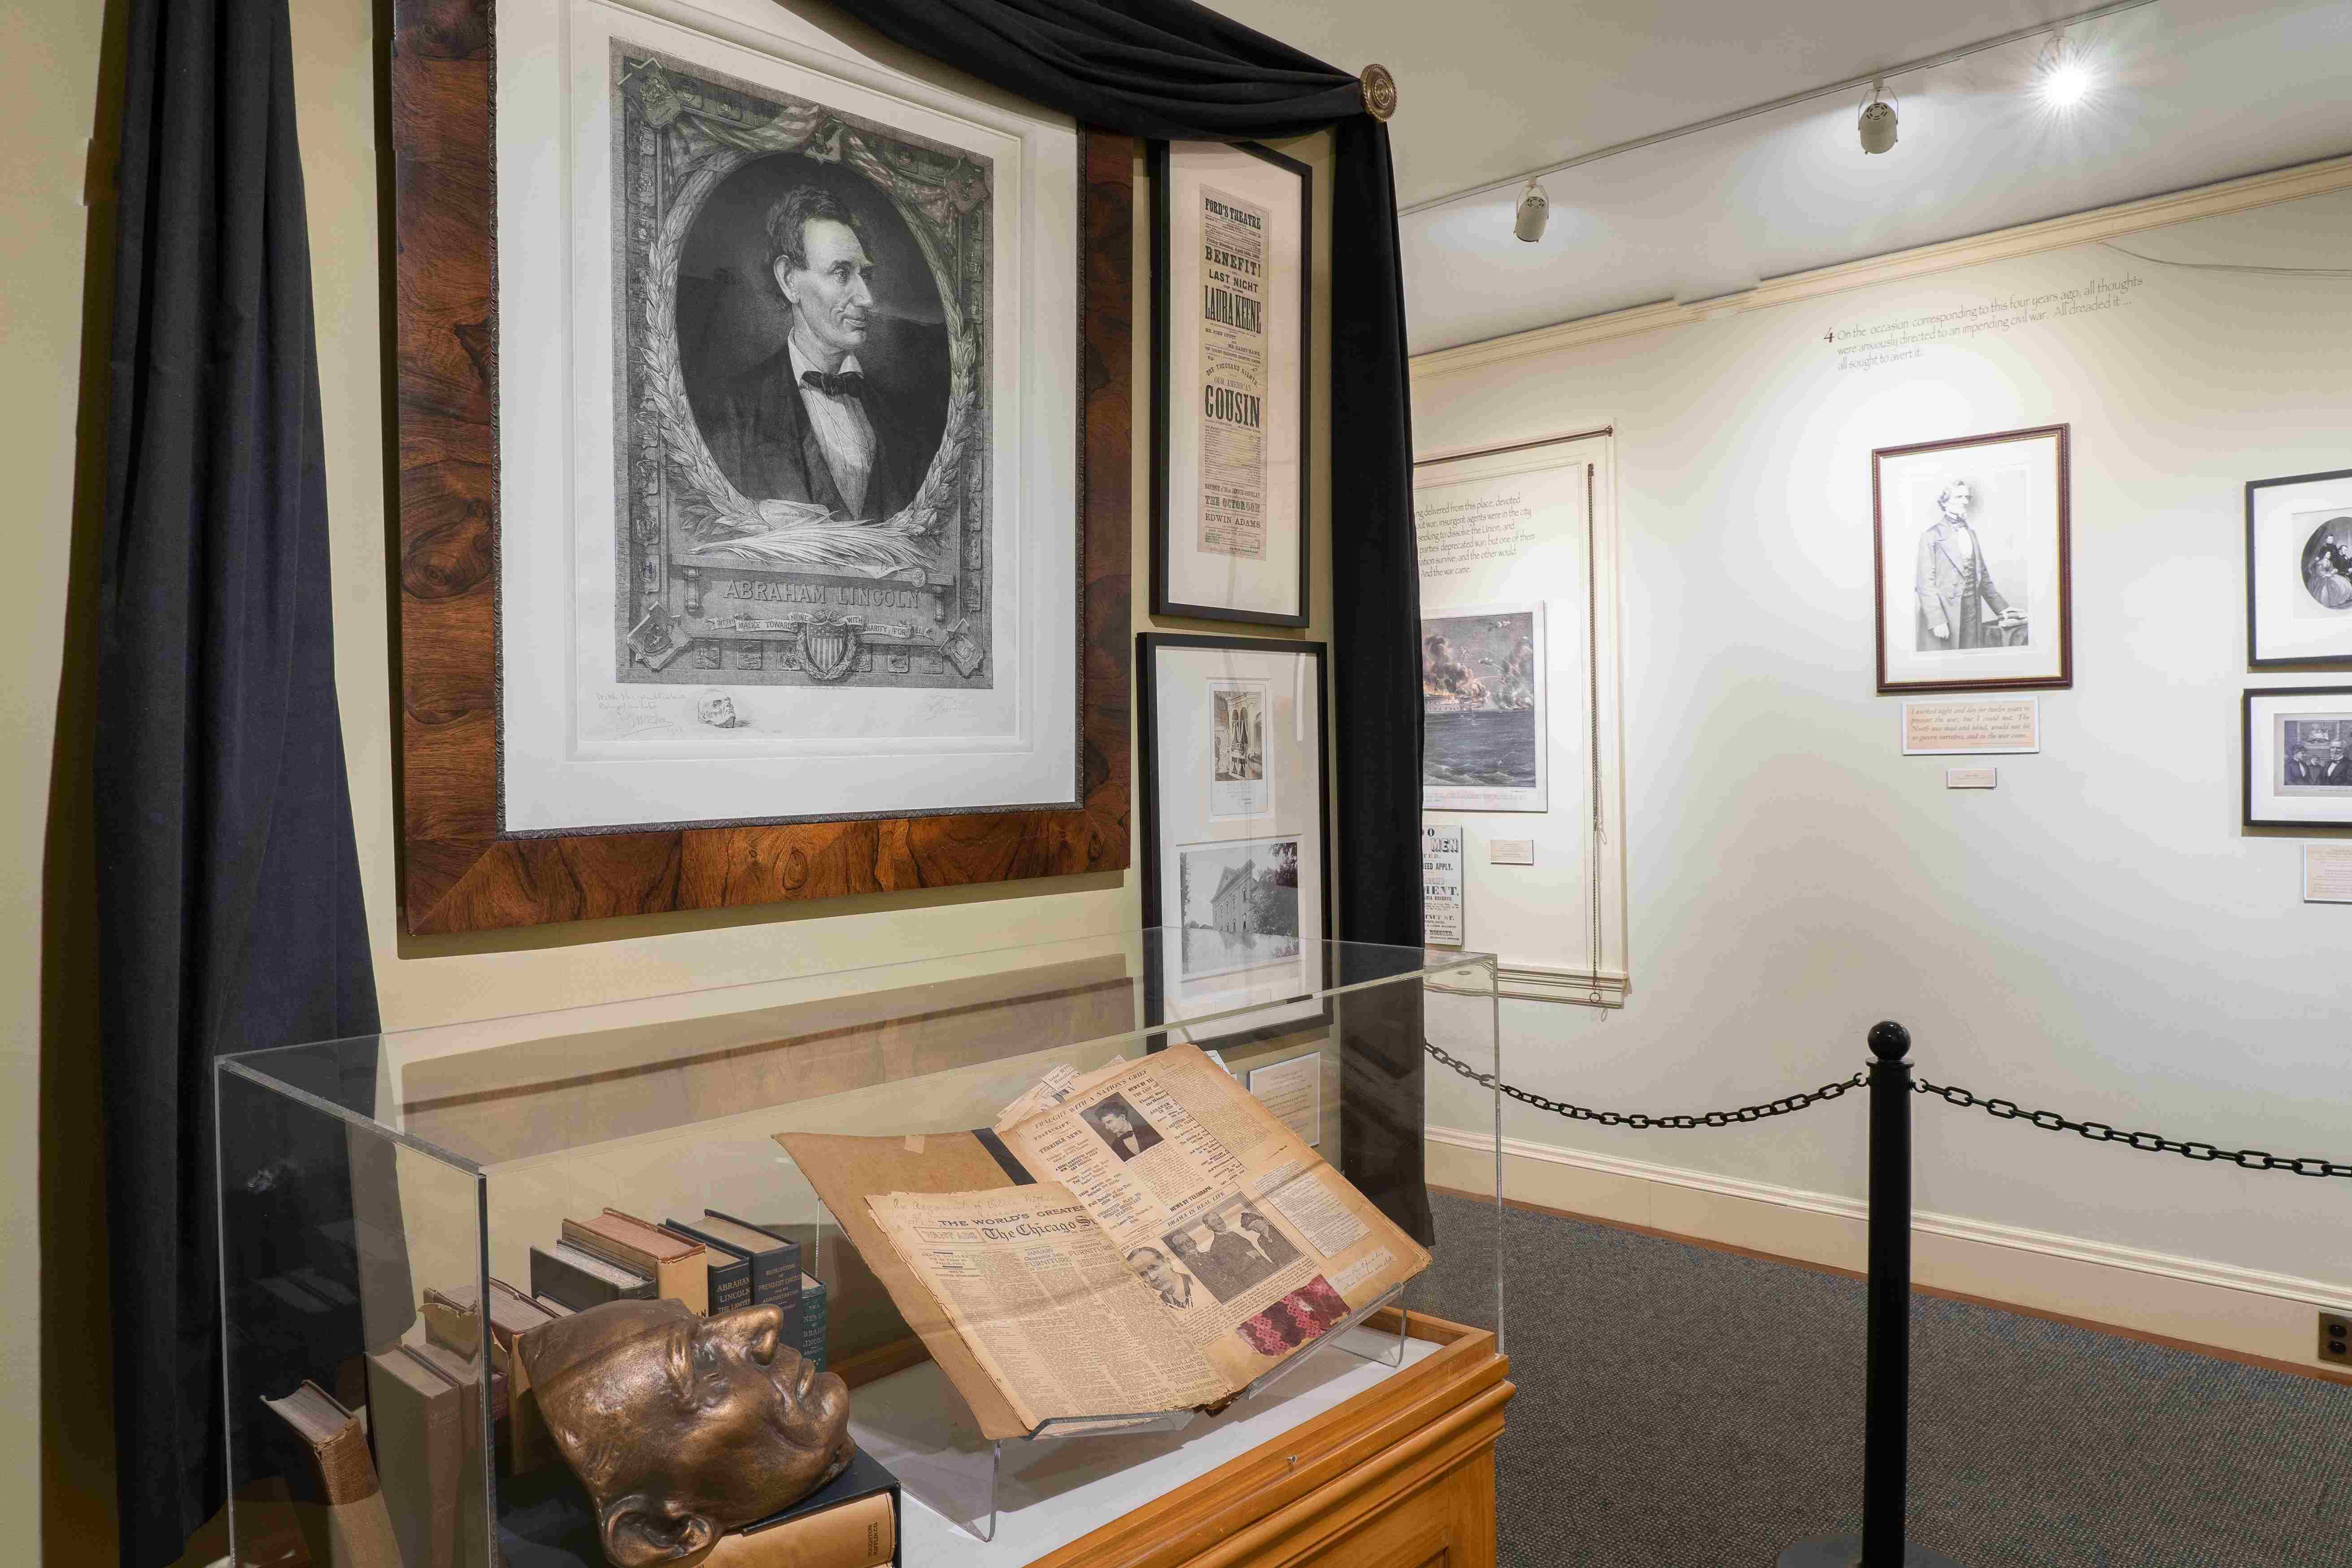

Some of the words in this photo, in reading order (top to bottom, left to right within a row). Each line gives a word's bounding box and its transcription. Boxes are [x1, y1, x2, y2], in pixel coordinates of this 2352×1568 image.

[1205, 198, 1228, 218] FORD'S
[1229, 207, 1261, 230] THEATRE
[1205, 245, 1261, 278] BENEFIT!
[1209, 268, 1230, 284] LAST
[1233, 277, 1259, 293] NIGHT
[1205, 285, 1233, 326] LAURA
[1235, 294, 1261, 334] KEENE
[1823, 327, 1835, 343] 4
[1837, 330, 1851, 340] On
[1853, 324, 1867, 337] the
[1870, 319, 1908, 335] occasion
[1912, 305, 1977, 328] corresponding
[1979, 305, 1989, 314] to
[1991, 297, 2008, 313] this
[2010, 294, 2030, 309] four
[2032, 294, 2058, 311] years
[2084, 279, 2095, 296] all
[2097, 273, 2143, 294] thoughts
[1837, 345, 1857, 355] were
[1859, 333, 1898, 353] anxiously
[1900, 324, 1936, 345] directed
[1938, 328, 1948, 338] to
[1949, 327, 1960, 336] an
[1962, 314, 2010, 339] impending
[2011, 308, 2027, 325] civil
[2054, 301, 2067, 318] All
[2069, 294, 2110, 315] dreaded
[2113, 294, 2120, 306] it
[1206, 367, 1215, 377] ONE
[1216, 362, 1240, 371] THOUSAND
[1837, 357, 1847, 370] all
[1849, 351, 1877, 371] sought
[1880, 353, 1890, 363] to
[1890, 351, 1913, 362] avert
[1214, 376, 1225, 385] OUR
[1227, 380, 1253, 392] AMERICAN
[1205, 384, 1261, 428] COUSIN
[1205, 495, 1220, 506] THE
[1424, 502, 1450, 516] delivered
[1450, 501, 1464, 513] from
[1464, 498, 1475, 510] this
[1496, 491, 1521, 506] devoted
[1205, 513, 1232, 524] EDWIN
[1235, 518, 1261, 528] ADAMS
[1439, 515, 1465, 529] insurgent
[1466, 513, 1486, 528] agents
[1487, 512, 1501, 521] were
[1508, 505, 1519, 517] the
[1520, 506, 1532, 520] city
[1418, 529, 1439, 543] seeking
[1440, 531, 1445, 539] to
[1446, 525, 1471, 539] dissolve
[1471, 524, 1482, 535] the
[1503, 518, 1515, 531] and
[1419, 545, 1439, 559] parties
[1440, 536, 1473, 556] deprecated
[1488, 533, 1498, 545] but
[1512, 531, 1519, 542] of
[1520, 528, 1536, 542] them
[1458, 549, 1469, 562] and
[1470, 548, 1480, 560] the
[1481, 546, 1497, 559] other
[1498, 543, 1516, 557] would
[1421, 566, 1432, 578] And
[1433, 565, 1443, 576] the
[723, 579, 826, 604] ABRAHAM
[837, 586, 919, 609] LINCOLN
[1430, 838, 1459, 853] MEN
[1034, 1110, 1067, 1129] FRAUGHT
[1069, 1098, 1088, 1113] WITH
[1096, 1079, 1127, 1097] NATION'S
[1128, 1069, 1148, 1081] GRIEF
[1038, 1137, 1067, 1154] TERRIBLE
[971, 1213, 1030, 1225] WORLD'S
[1037, 1204, 1086, 1217] GREATES
[1167, 1213, 1188, 1228] DRAMA
[1189, 1208, 1196, 1216] IN
[1196, 1200, 1212, 1211] REAL
[1211, 1191, 1225, 1202] LIFE
[1169, 1202, 1184, 1212] NEWS
[982, 1227, 1016, 1242] The
[1016, 1221, 1077, 1237] Chicago
[1026, 1248, 1054, 1256] JANUARY
[1067, 1244, 1114, 1256] FURNITURE
[1024, 1256, 1072, 1267] FURNITURE
[758, 1279, 784, 1292] PRESIDENT
[718, 1305, 729, 1314] THE
[1155, 1362, 1171, 1370] THE
[1170, 1355, 1203, 1367] HOLLAND
[1159, 1361, 1196, 1376] FURNITURE
[1174, 1373, 1211, 1385] FURNITURE
[1125, 1393, 1140, 1402] THE
